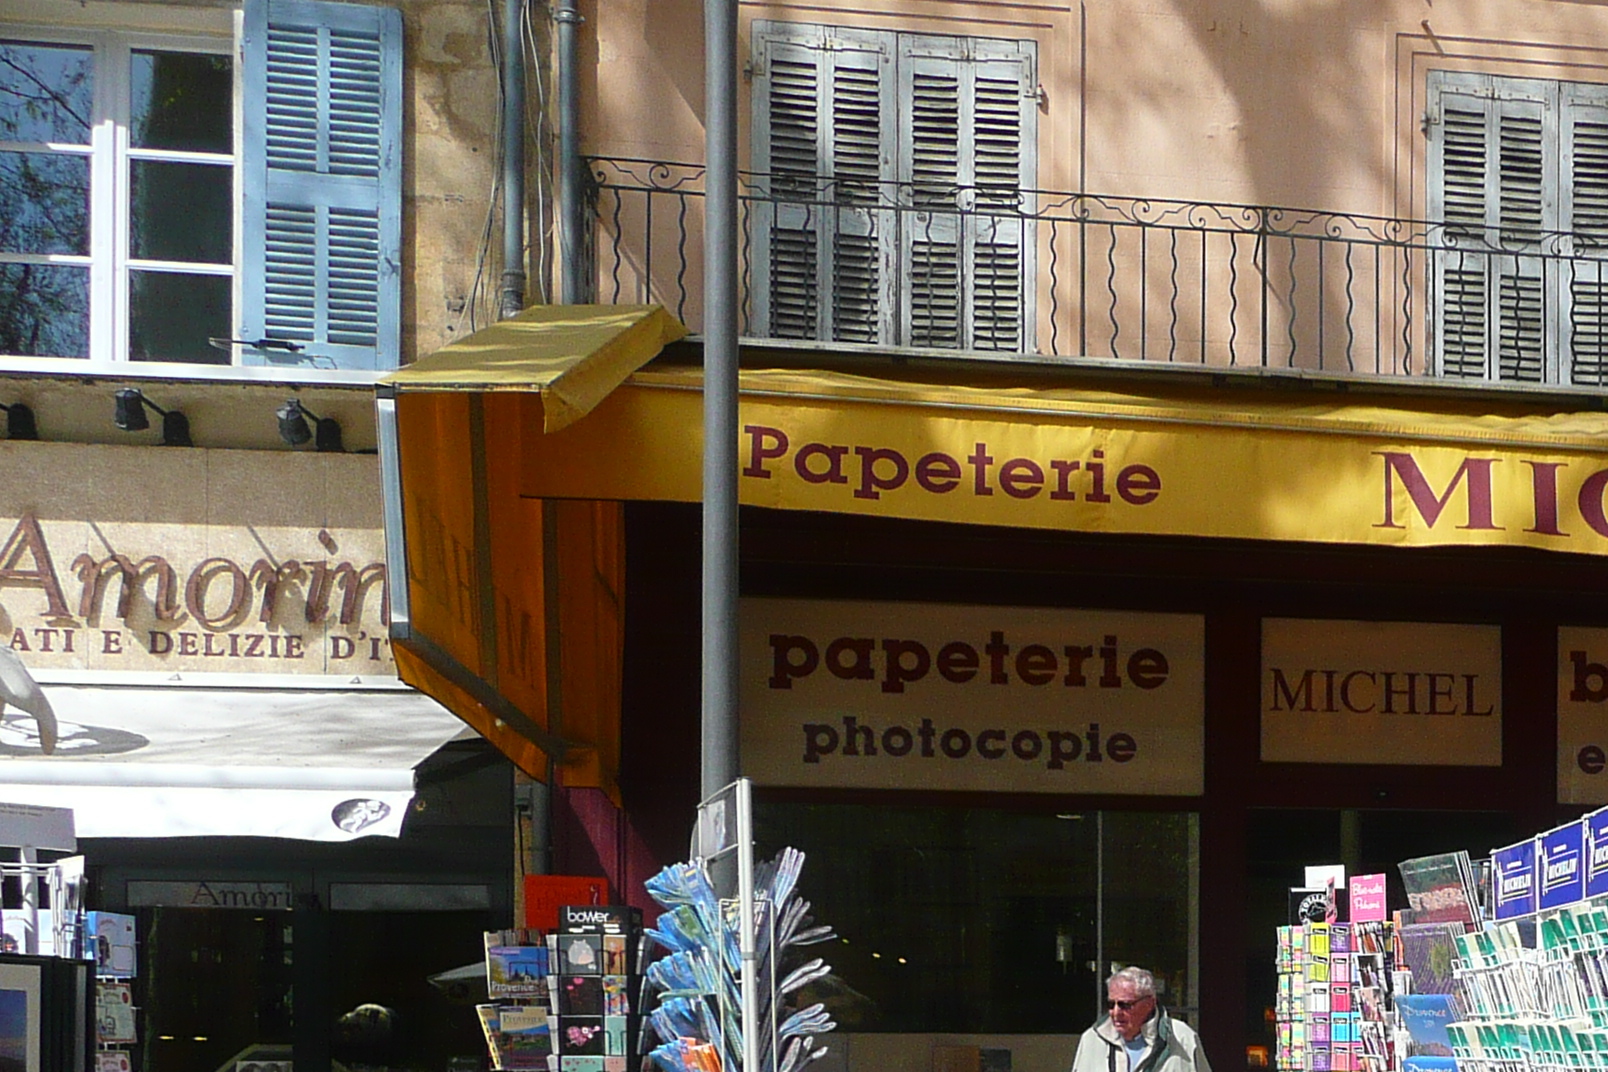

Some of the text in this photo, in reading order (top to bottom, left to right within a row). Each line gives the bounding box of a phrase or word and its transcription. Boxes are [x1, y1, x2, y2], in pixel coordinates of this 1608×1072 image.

[742, 424, 1163, 505] Papeterie
[102, 631, 122, 655] E
[148, 631, 305, 659] DELIZIE
[768, 630, 1170, 693] papeterie
[1269, 667, 1495, 718] MICHEL
[803, 716, 1138, 770] photocopie
[1548, 857, 1577, 880] MICHELIN
[567, 905, 610, 923] bower
[491, 980, 535, 993] Provence
